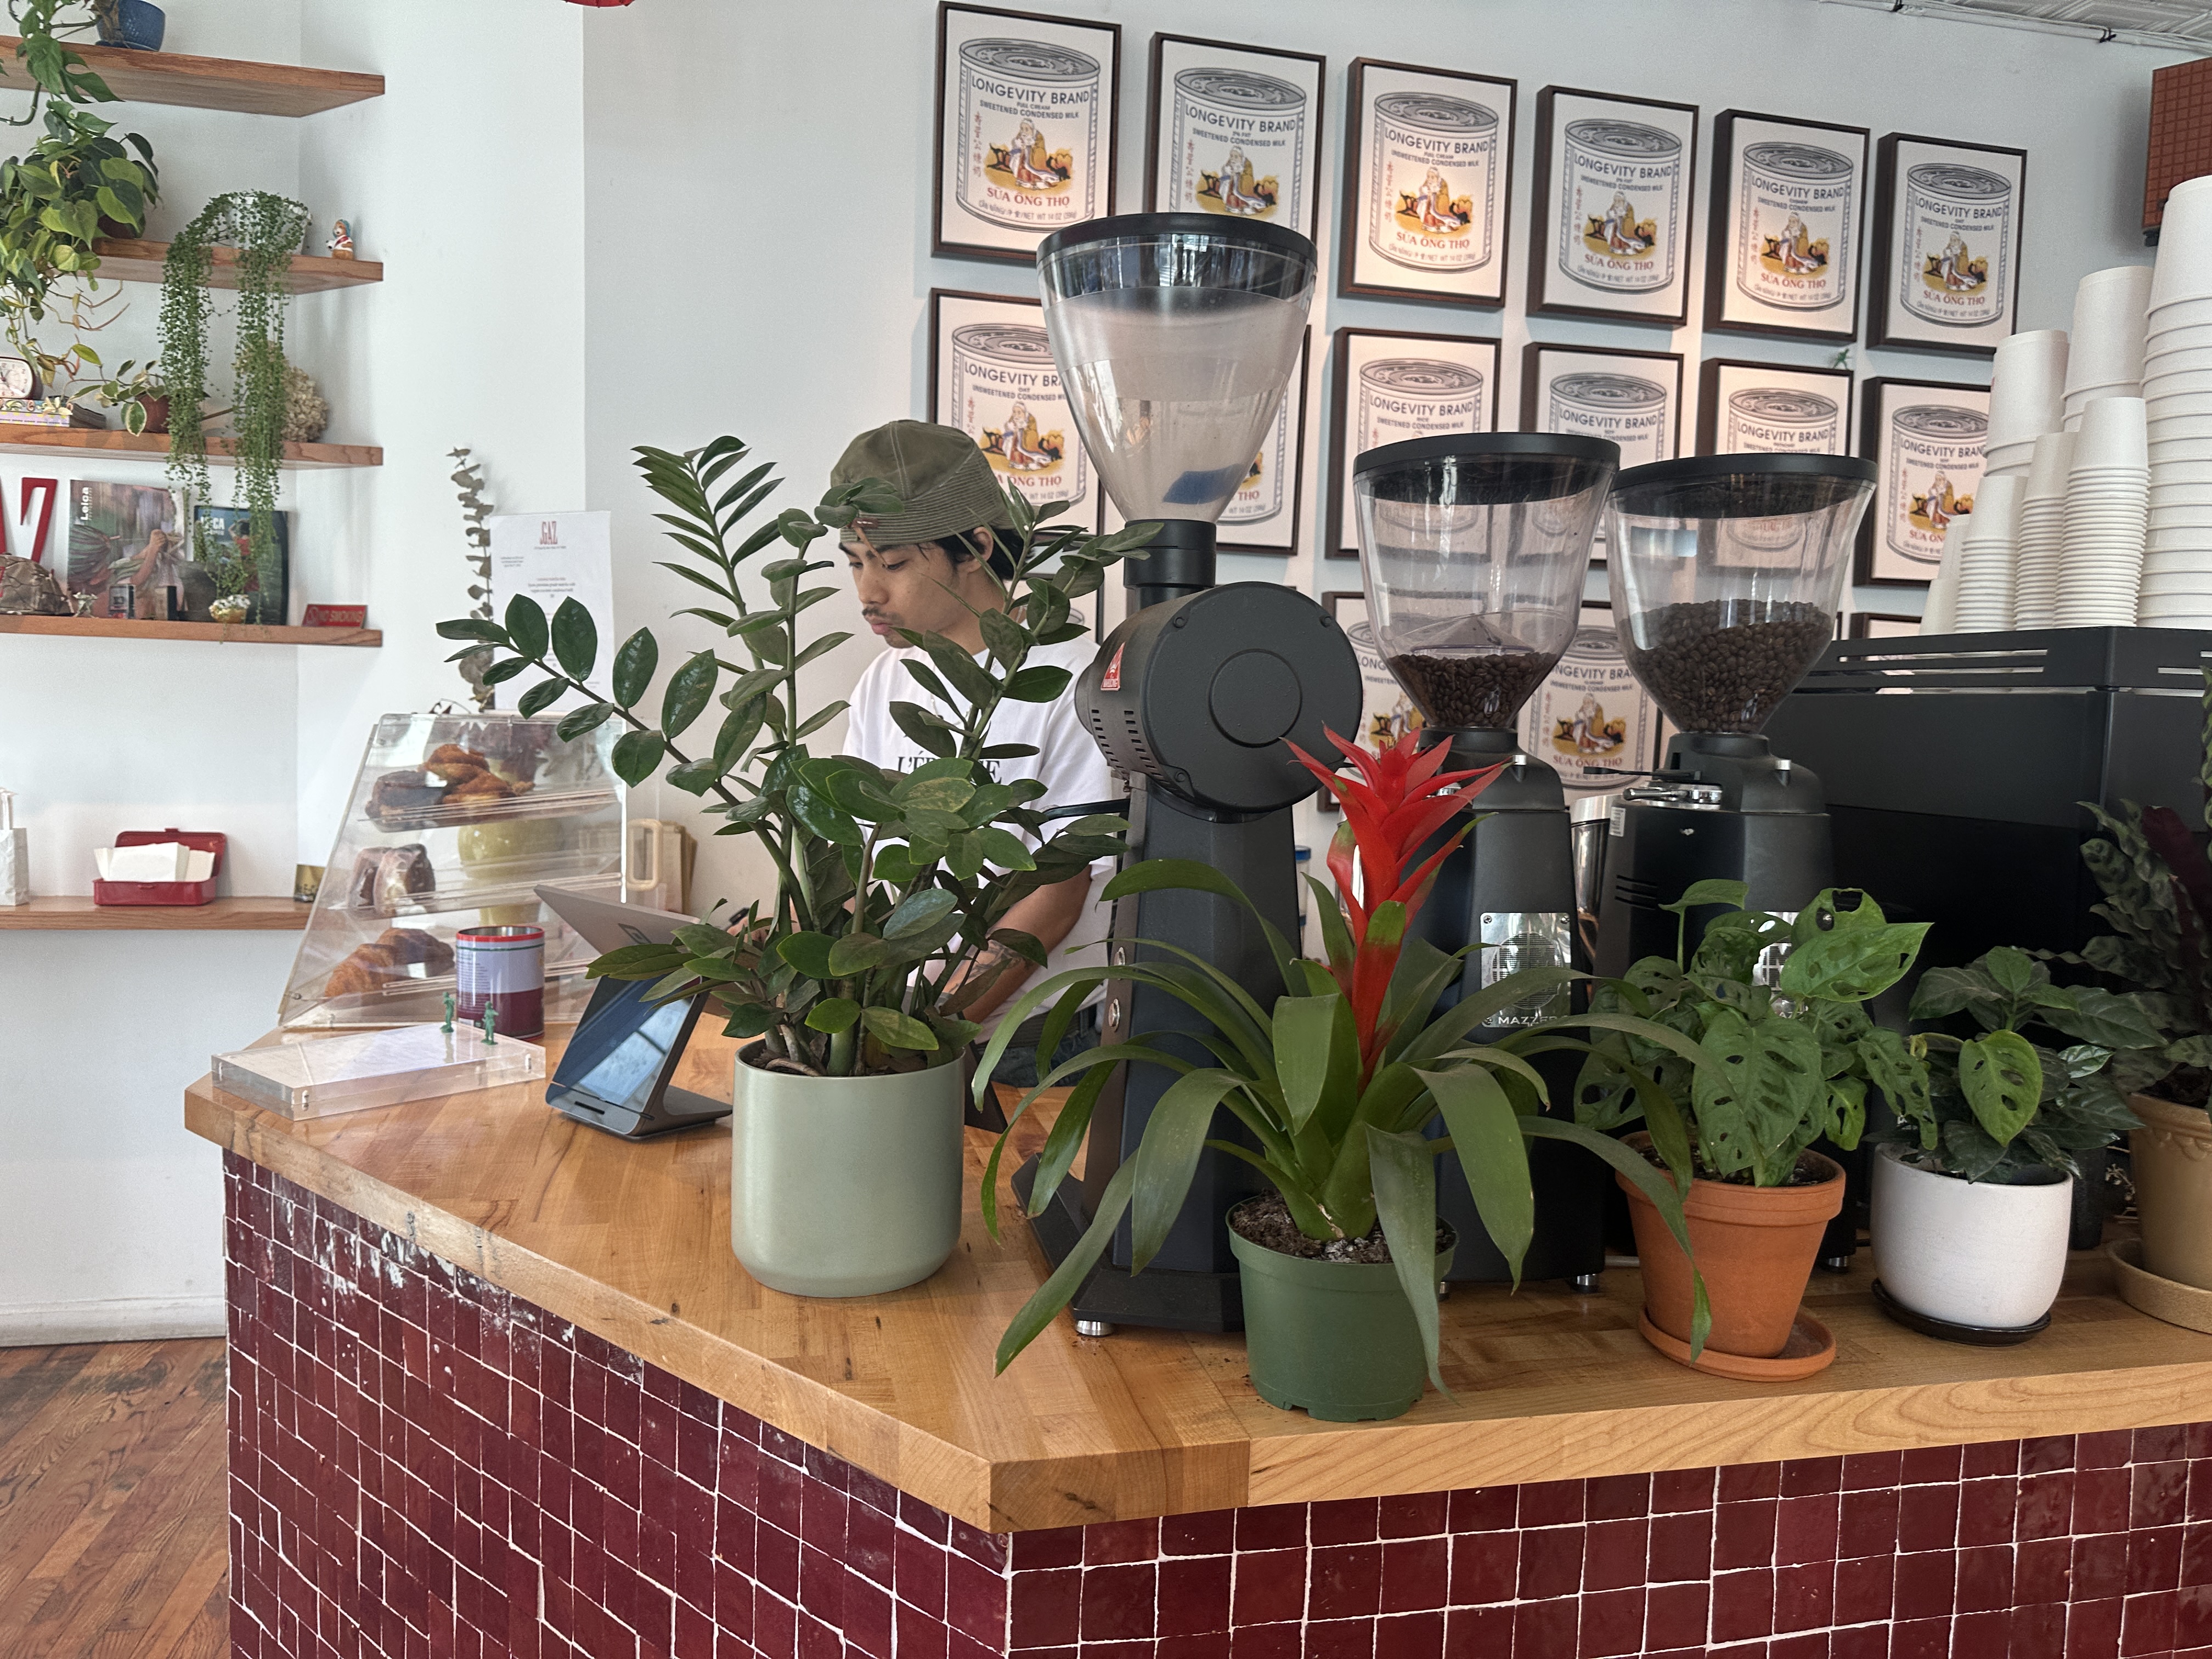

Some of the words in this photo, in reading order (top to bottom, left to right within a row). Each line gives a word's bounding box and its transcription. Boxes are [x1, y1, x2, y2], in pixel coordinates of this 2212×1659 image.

[972, 76, 1046, 103] LONGEVITY
[1051, 91, 1090, 104] BRAND
[980, 100, 1018, 115] SWEETENED
[1020, 110, 1063, 119] CONDENSED
[1186, 104, 1255, 132] LONGEVITY
[1260, 120, 1296, 132] BRAND
[1385, 126, 1451, 153] LONGEVITY
[1454, 140, 1488, 153] BRAND
[1575, 153, 1636, 178] LONGEVITY
[1640, 165, 1672, 179] BRAND
[1752, 176, 1809, 199] LONGEVITY
[1814, 187, 1843, 200] BRAND
[1915, 196, 1971, 218] LONGEVITY
[1974, 206, 2002, 219] BRAND
[965, 361, 1038, 386] LONGEVITY
[1370, 394, 1436, 415] LONGEVITY
[1440, 402, 1473, 416] BRAND
[1560, 408, 1622, 428] LONGEVITY
[1625, 415, 1657, 428] BRAND
[1737, 422, 1796, 442] LONGEVITY
[1799, 429, 1828, 442] BRAND
[1900, 438, 1955, 458] LONGEVITY
[81, 487, 89, 521] Leica
